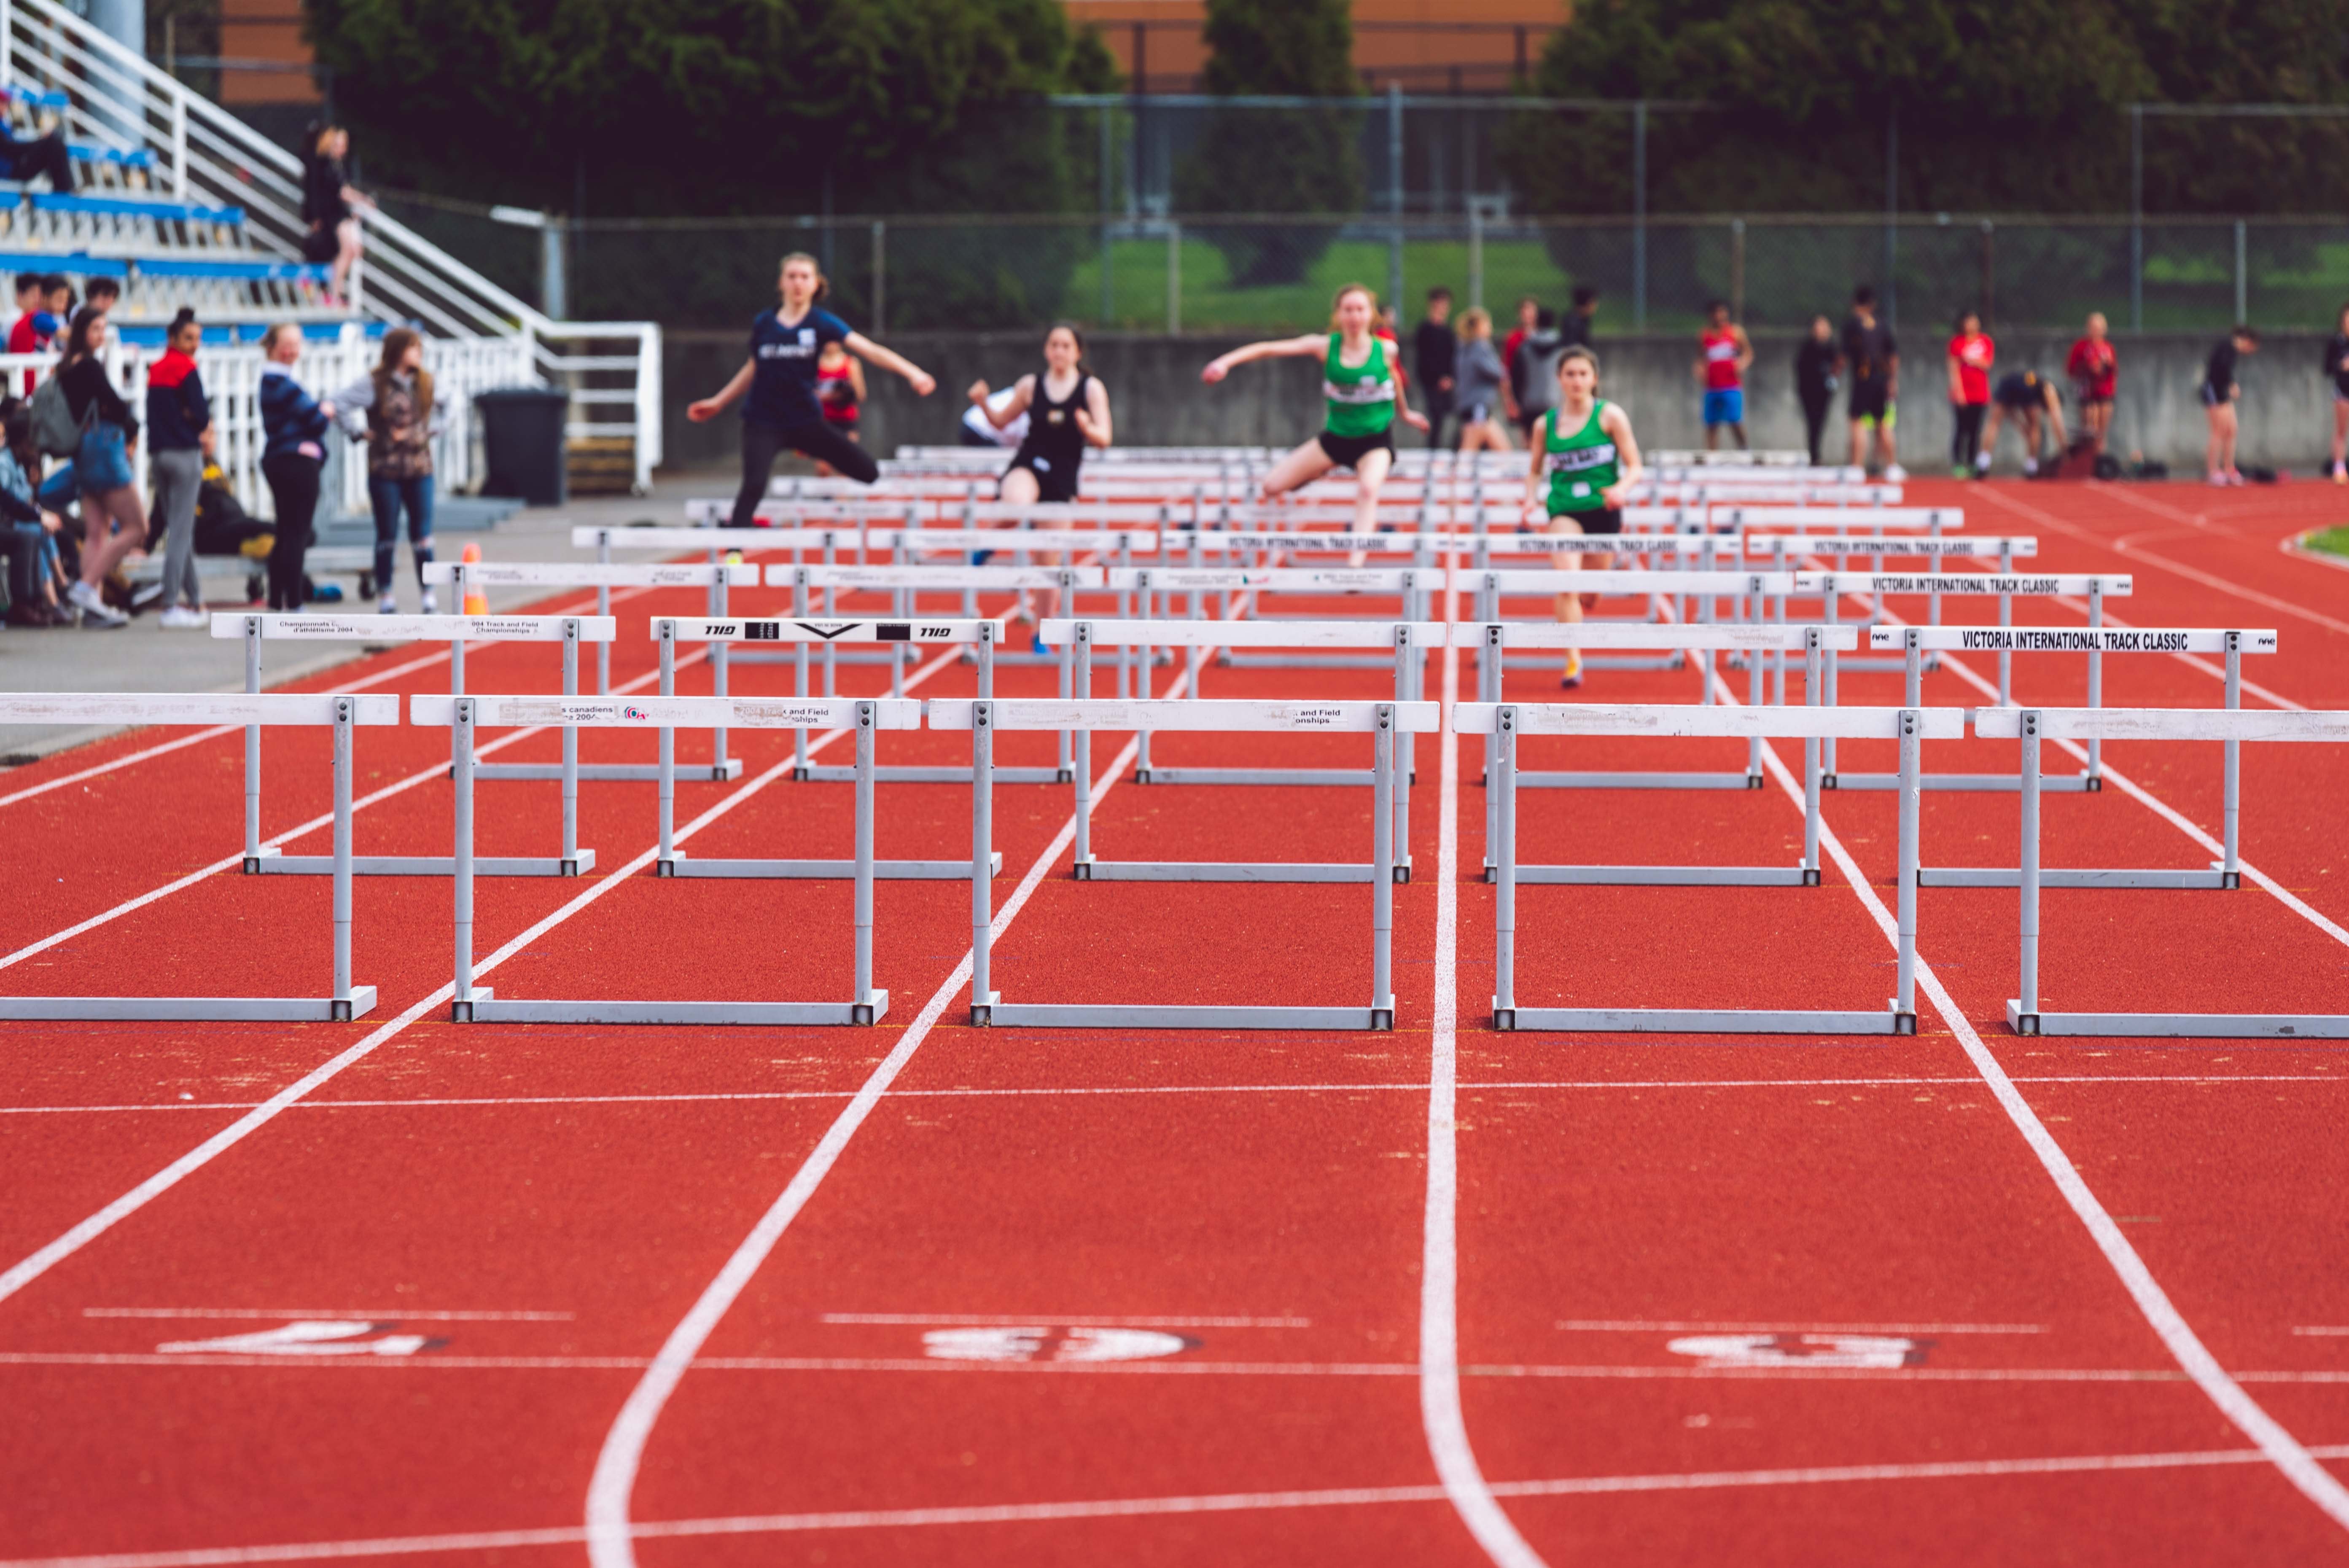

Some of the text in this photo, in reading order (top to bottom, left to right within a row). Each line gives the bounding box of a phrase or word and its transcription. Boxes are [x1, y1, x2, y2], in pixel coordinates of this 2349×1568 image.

[1229, 538, 1388, 550] VICTORIA INTERNATIONAL TRACK CLASSIC
[1519, 540, 1677, 551] VICTORIA INTERNATIONAL TRACK CLASSIC
[1815, 541, 1974, 554] VICTORIA INTERNATIONAL TRACK CLASSIC
[1872, 577, 2059, 592] VICTORIA INTERNATIONAL TRACK CLASSIC
[705, 626, 736, 635] GILL
[920, 628, 951, 637] GILL
[1963, 631, 2188, 650] VICTORIA INTERNATIONAL TRACK CLASSIC
